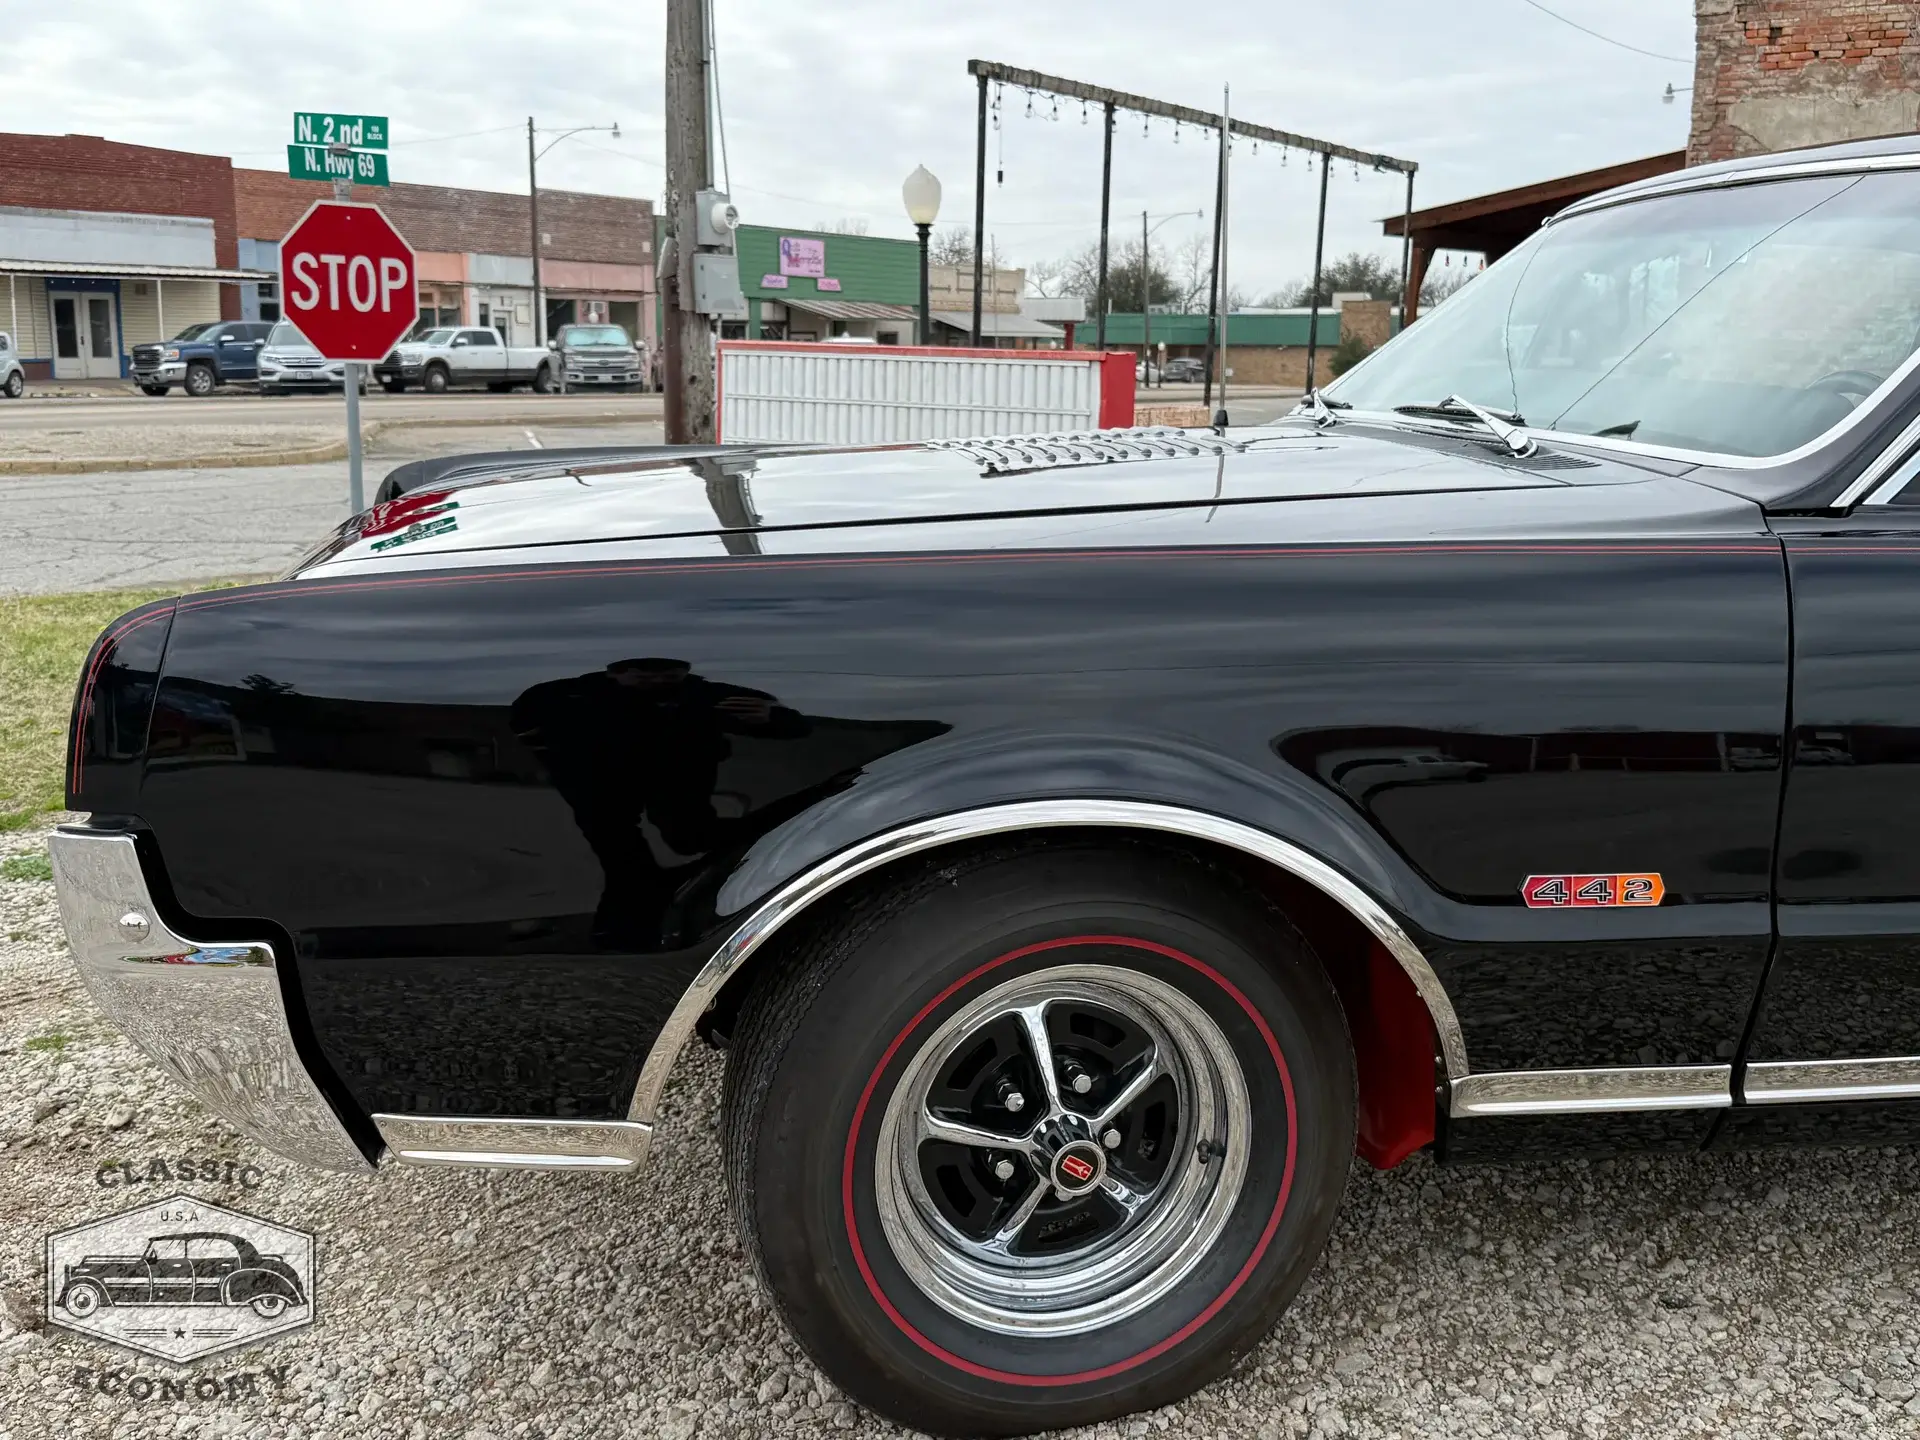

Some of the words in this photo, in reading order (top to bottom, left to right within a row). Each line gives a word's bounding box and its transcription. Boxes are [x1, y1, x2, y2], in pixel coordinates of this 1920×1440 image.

[298, 115, 318, 142] N.
[304, 147, 321, 172] N.
[324, 149, 354, 180] Hwy
[358, 153, 375, 178] 69
[291, 252, 408, 313] STOP
